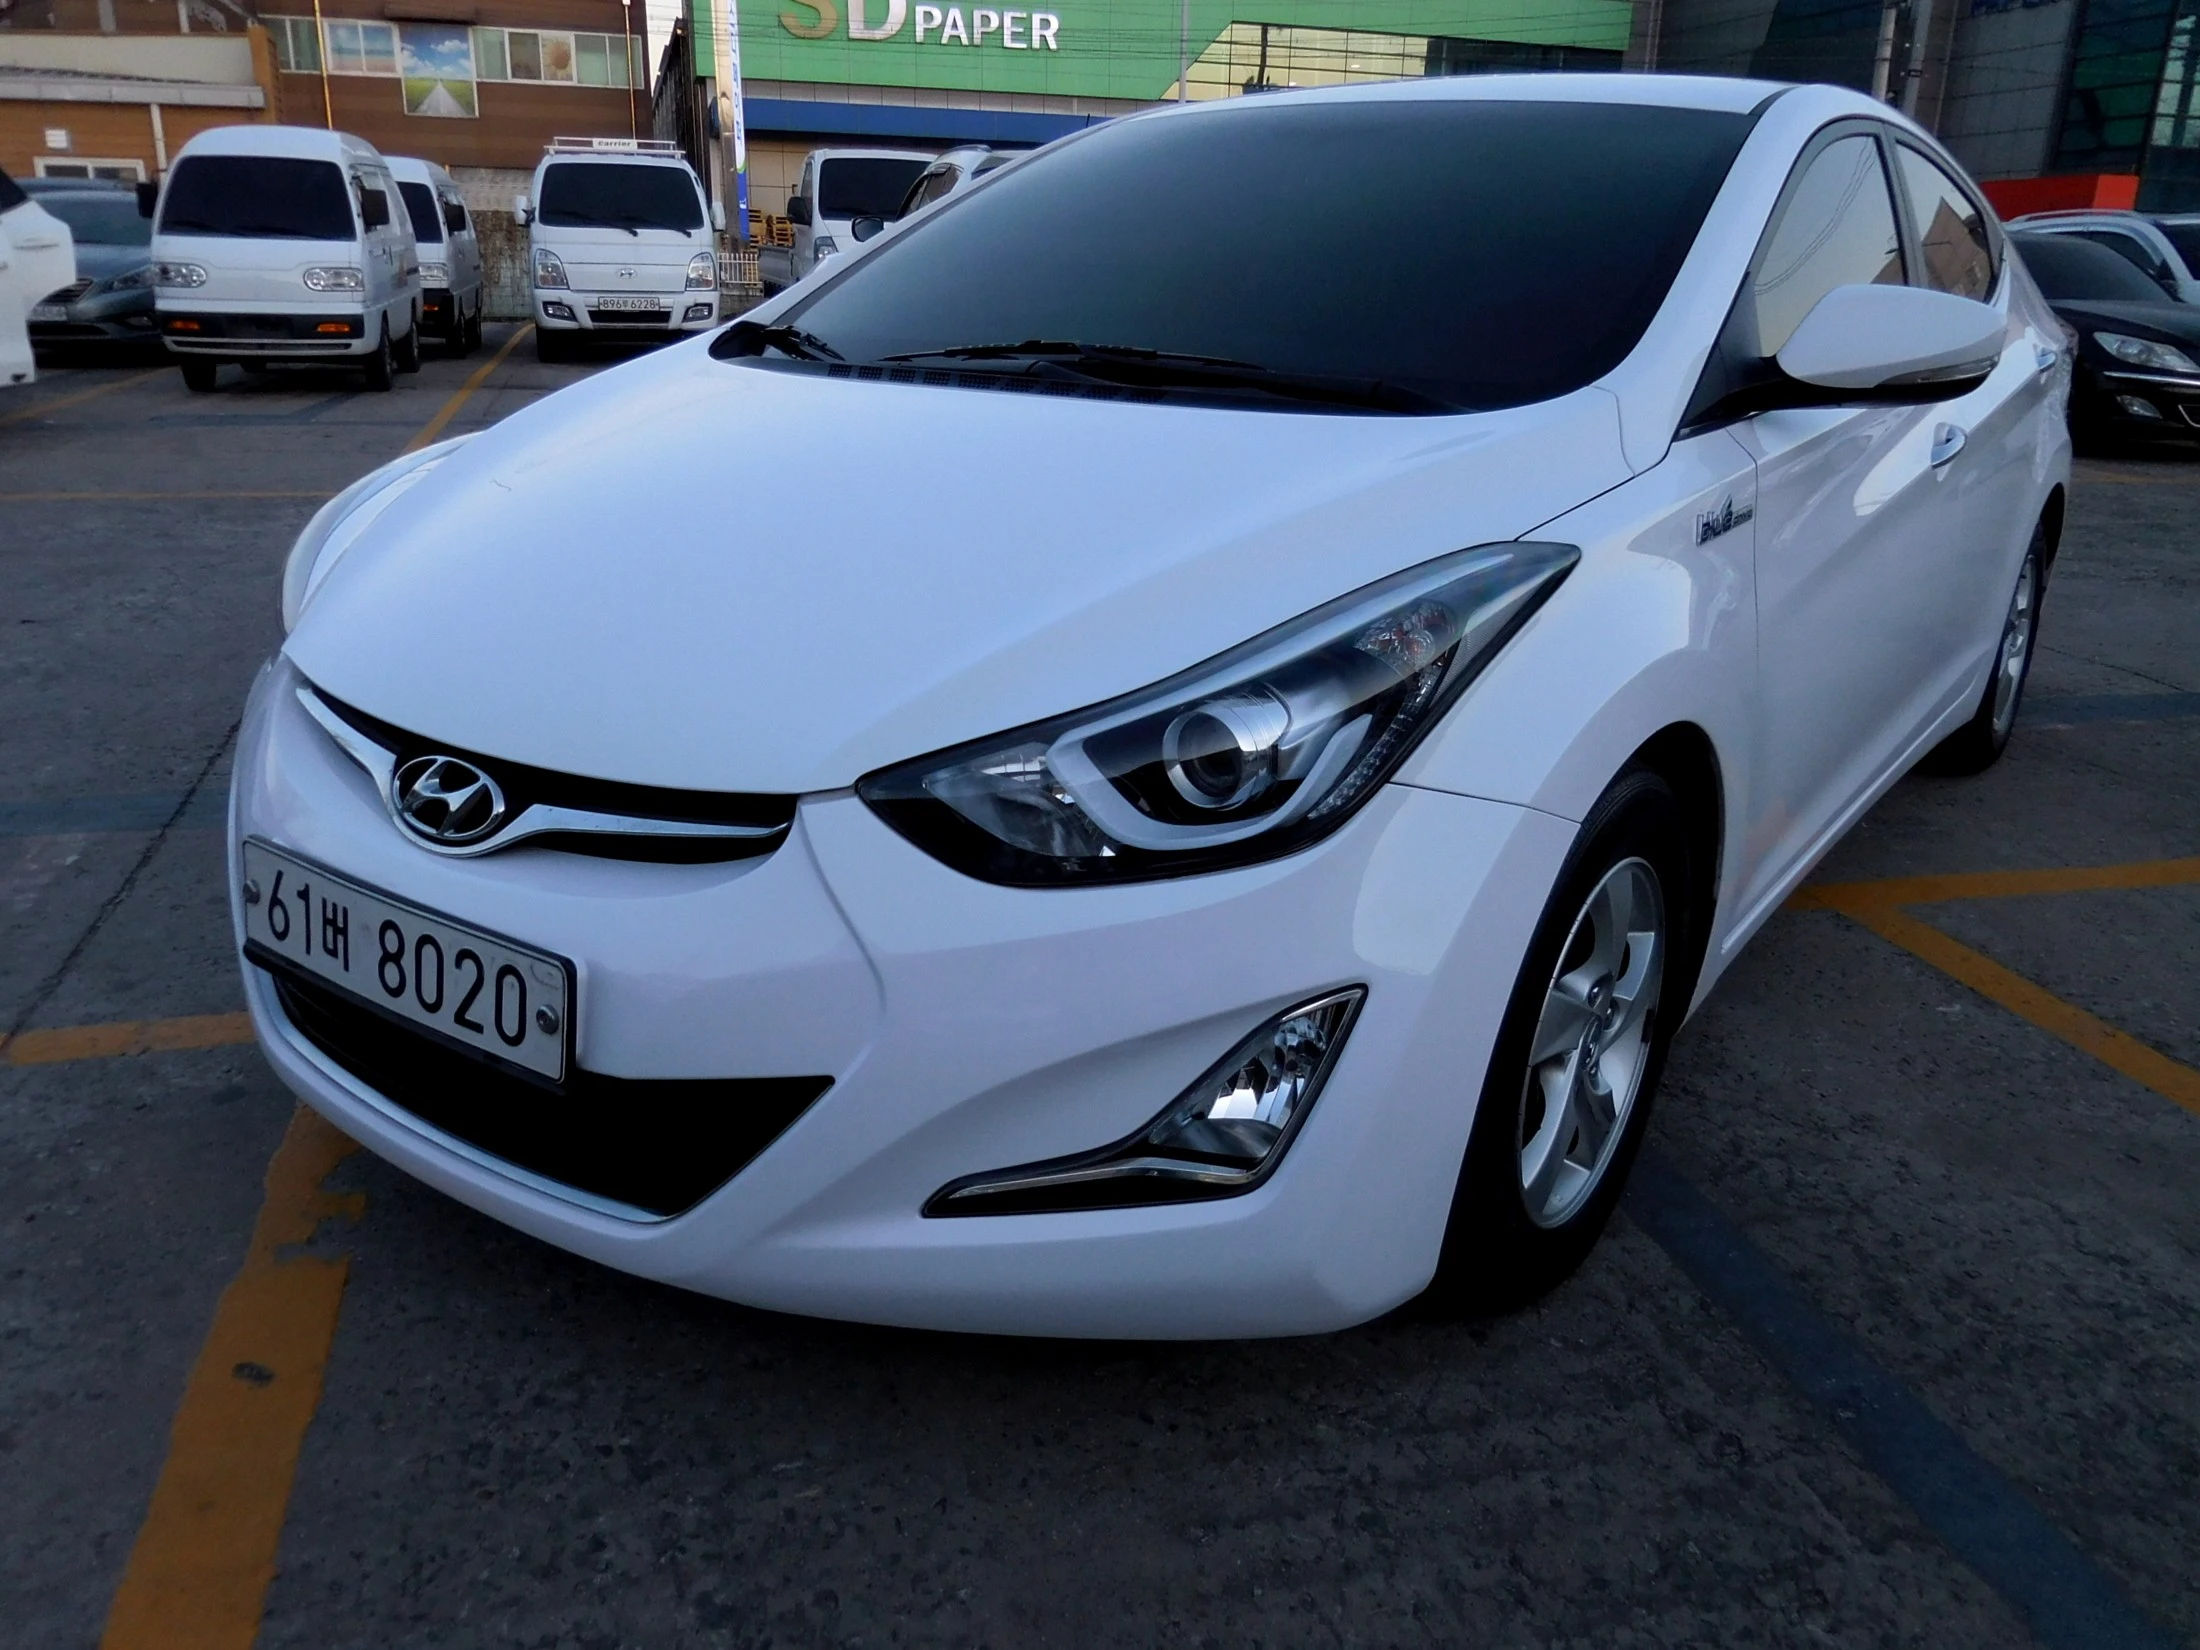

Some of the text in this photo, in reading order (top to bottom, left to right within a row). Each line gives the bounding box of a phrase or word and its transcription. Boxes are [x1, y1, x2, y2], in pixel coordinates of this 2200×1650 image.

[915, 5, 1060, 51] PAPER
[631, 299, 656, 309] 6228
[267, 869, 528, 1047] 61버 8020
